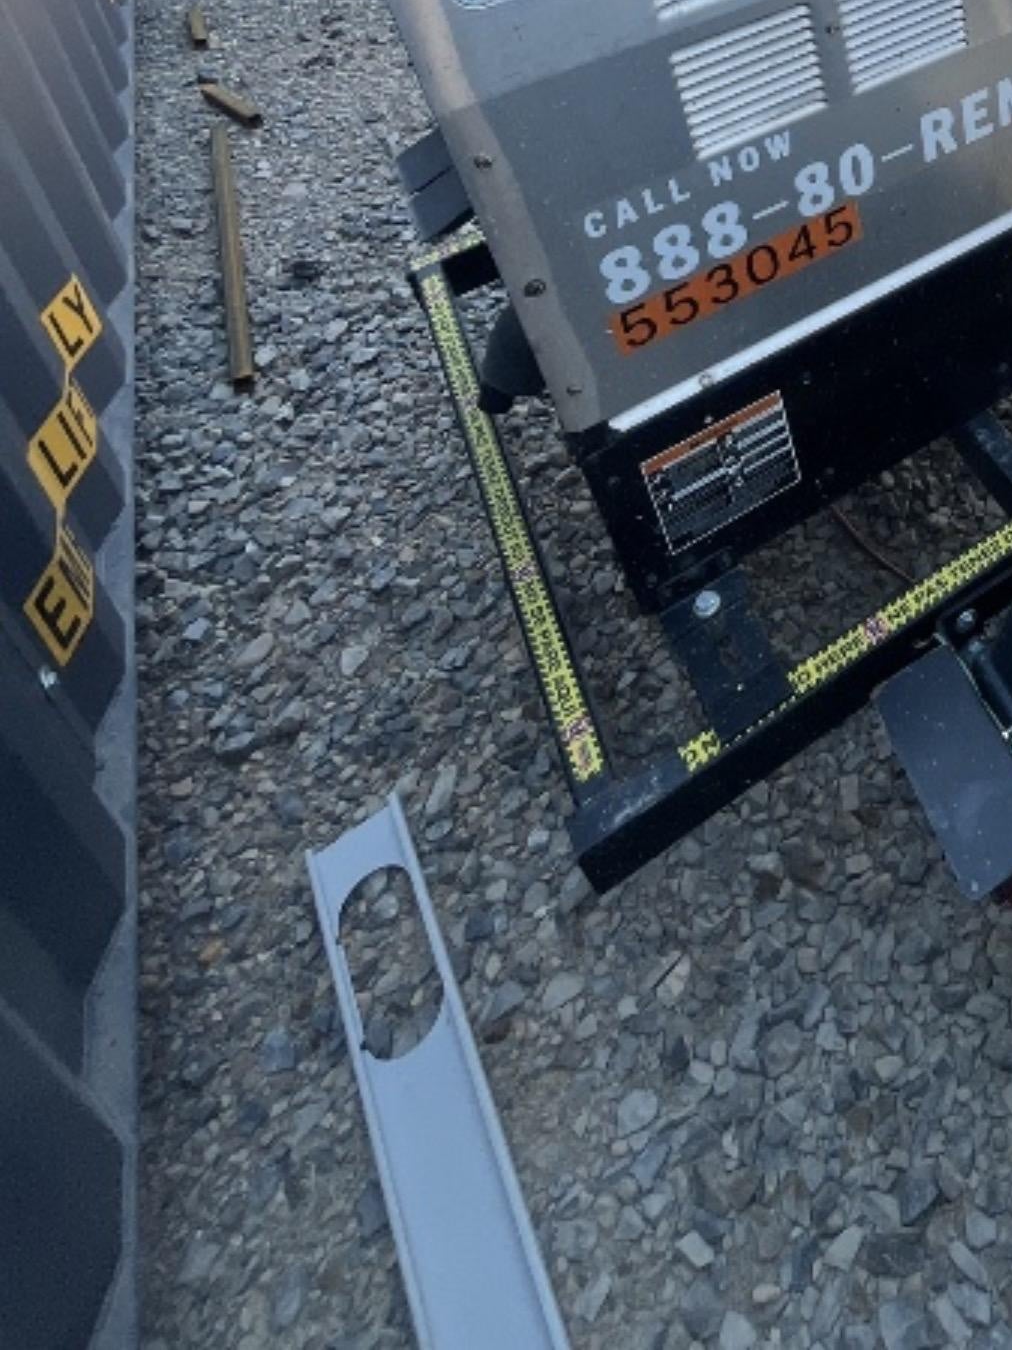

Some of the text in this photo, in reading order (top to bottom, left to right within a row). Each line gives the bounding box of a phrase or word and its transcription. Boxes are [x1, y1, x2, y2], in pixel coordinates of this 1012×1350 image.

[582, 131, 792, 239] CALL NOW
[618, 205, 855, 348] 553045
